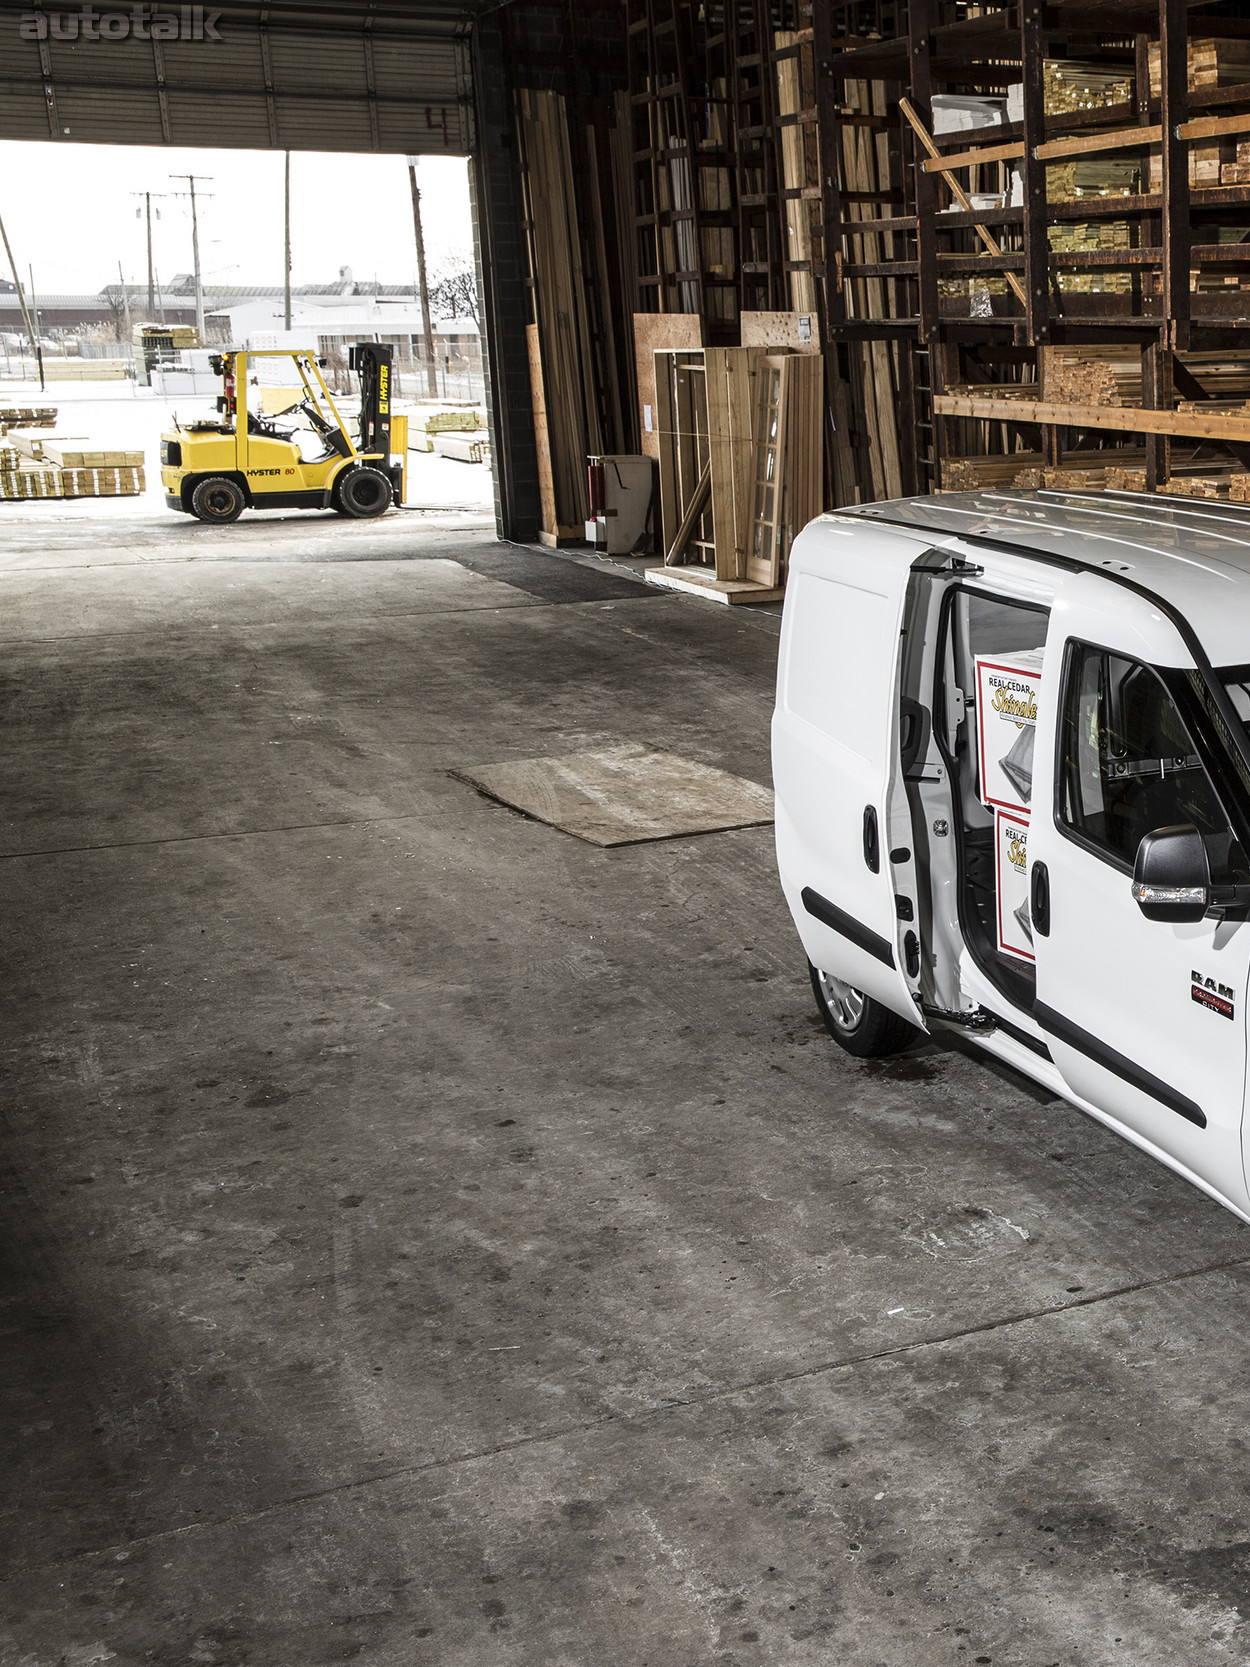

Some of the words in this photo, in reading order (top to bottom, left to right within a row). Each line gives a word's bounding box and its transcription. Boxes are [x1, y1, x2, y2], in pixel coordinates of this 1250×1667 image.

[425, 106, 449, 146] 4
[379, 364, 388, 400] HYSTER
[246, 468, 281, 476] HYSTER
[988, 677, 1006, 688] REAL
[1007, 681, 1031, 694] CEDAR
[1005, 829, 1020, 842] REAL
[1191, 969, 1235, 1001] RAM
[1202, 1000, 1220, 1013] CITY
